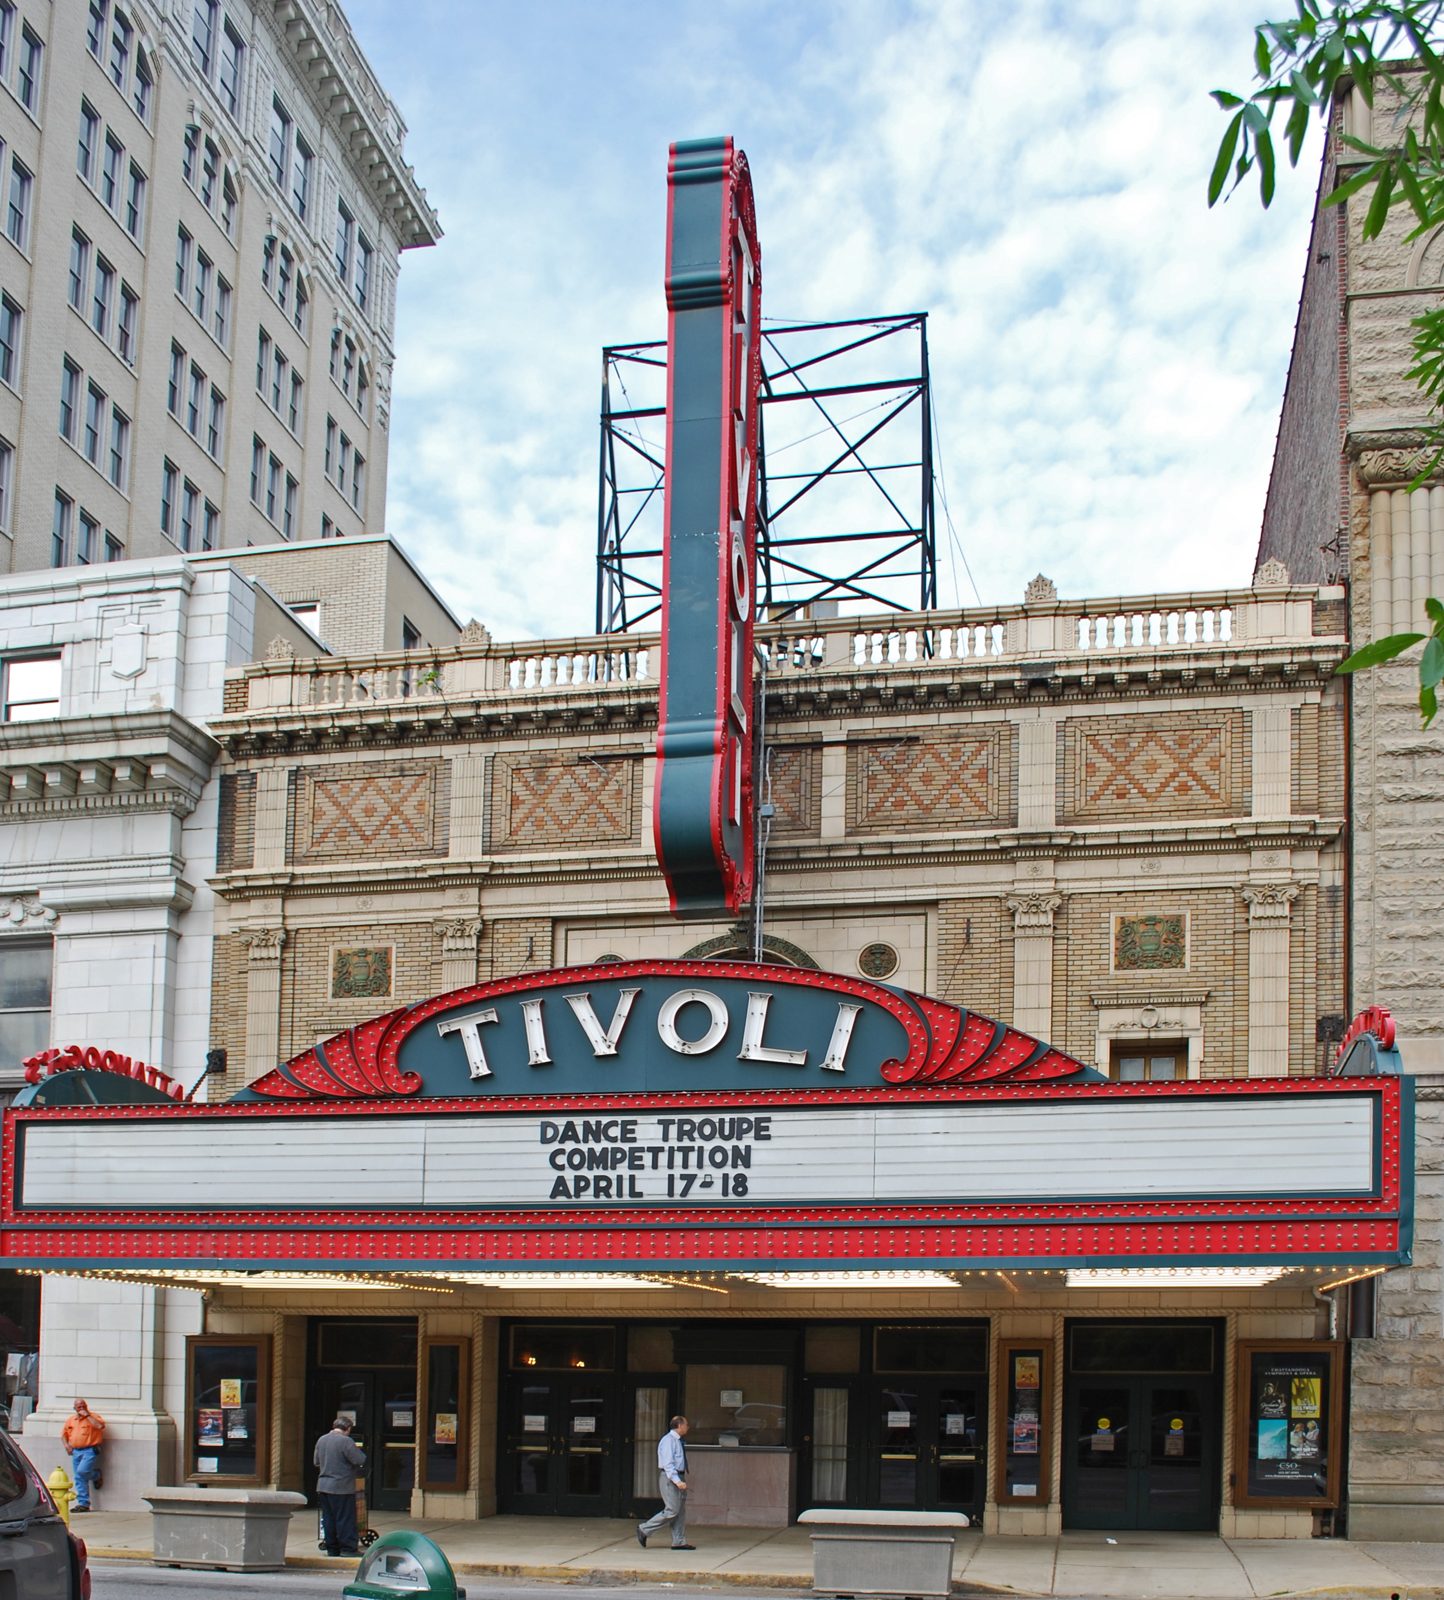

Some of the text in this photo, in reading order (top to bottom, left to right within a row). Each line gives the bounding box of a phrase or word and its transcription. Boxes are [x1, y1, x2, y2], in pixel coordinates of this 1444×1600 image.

[730, 216, 754, 826] TIVOLI
[436, 987, 864, 1080] TIVOLI
[540, 1116, 772, 1144] DANCE TROUPE
[548, 1144, 752, 1171] COMPETITION
[549, 1174, 644, 1199] APRIL
